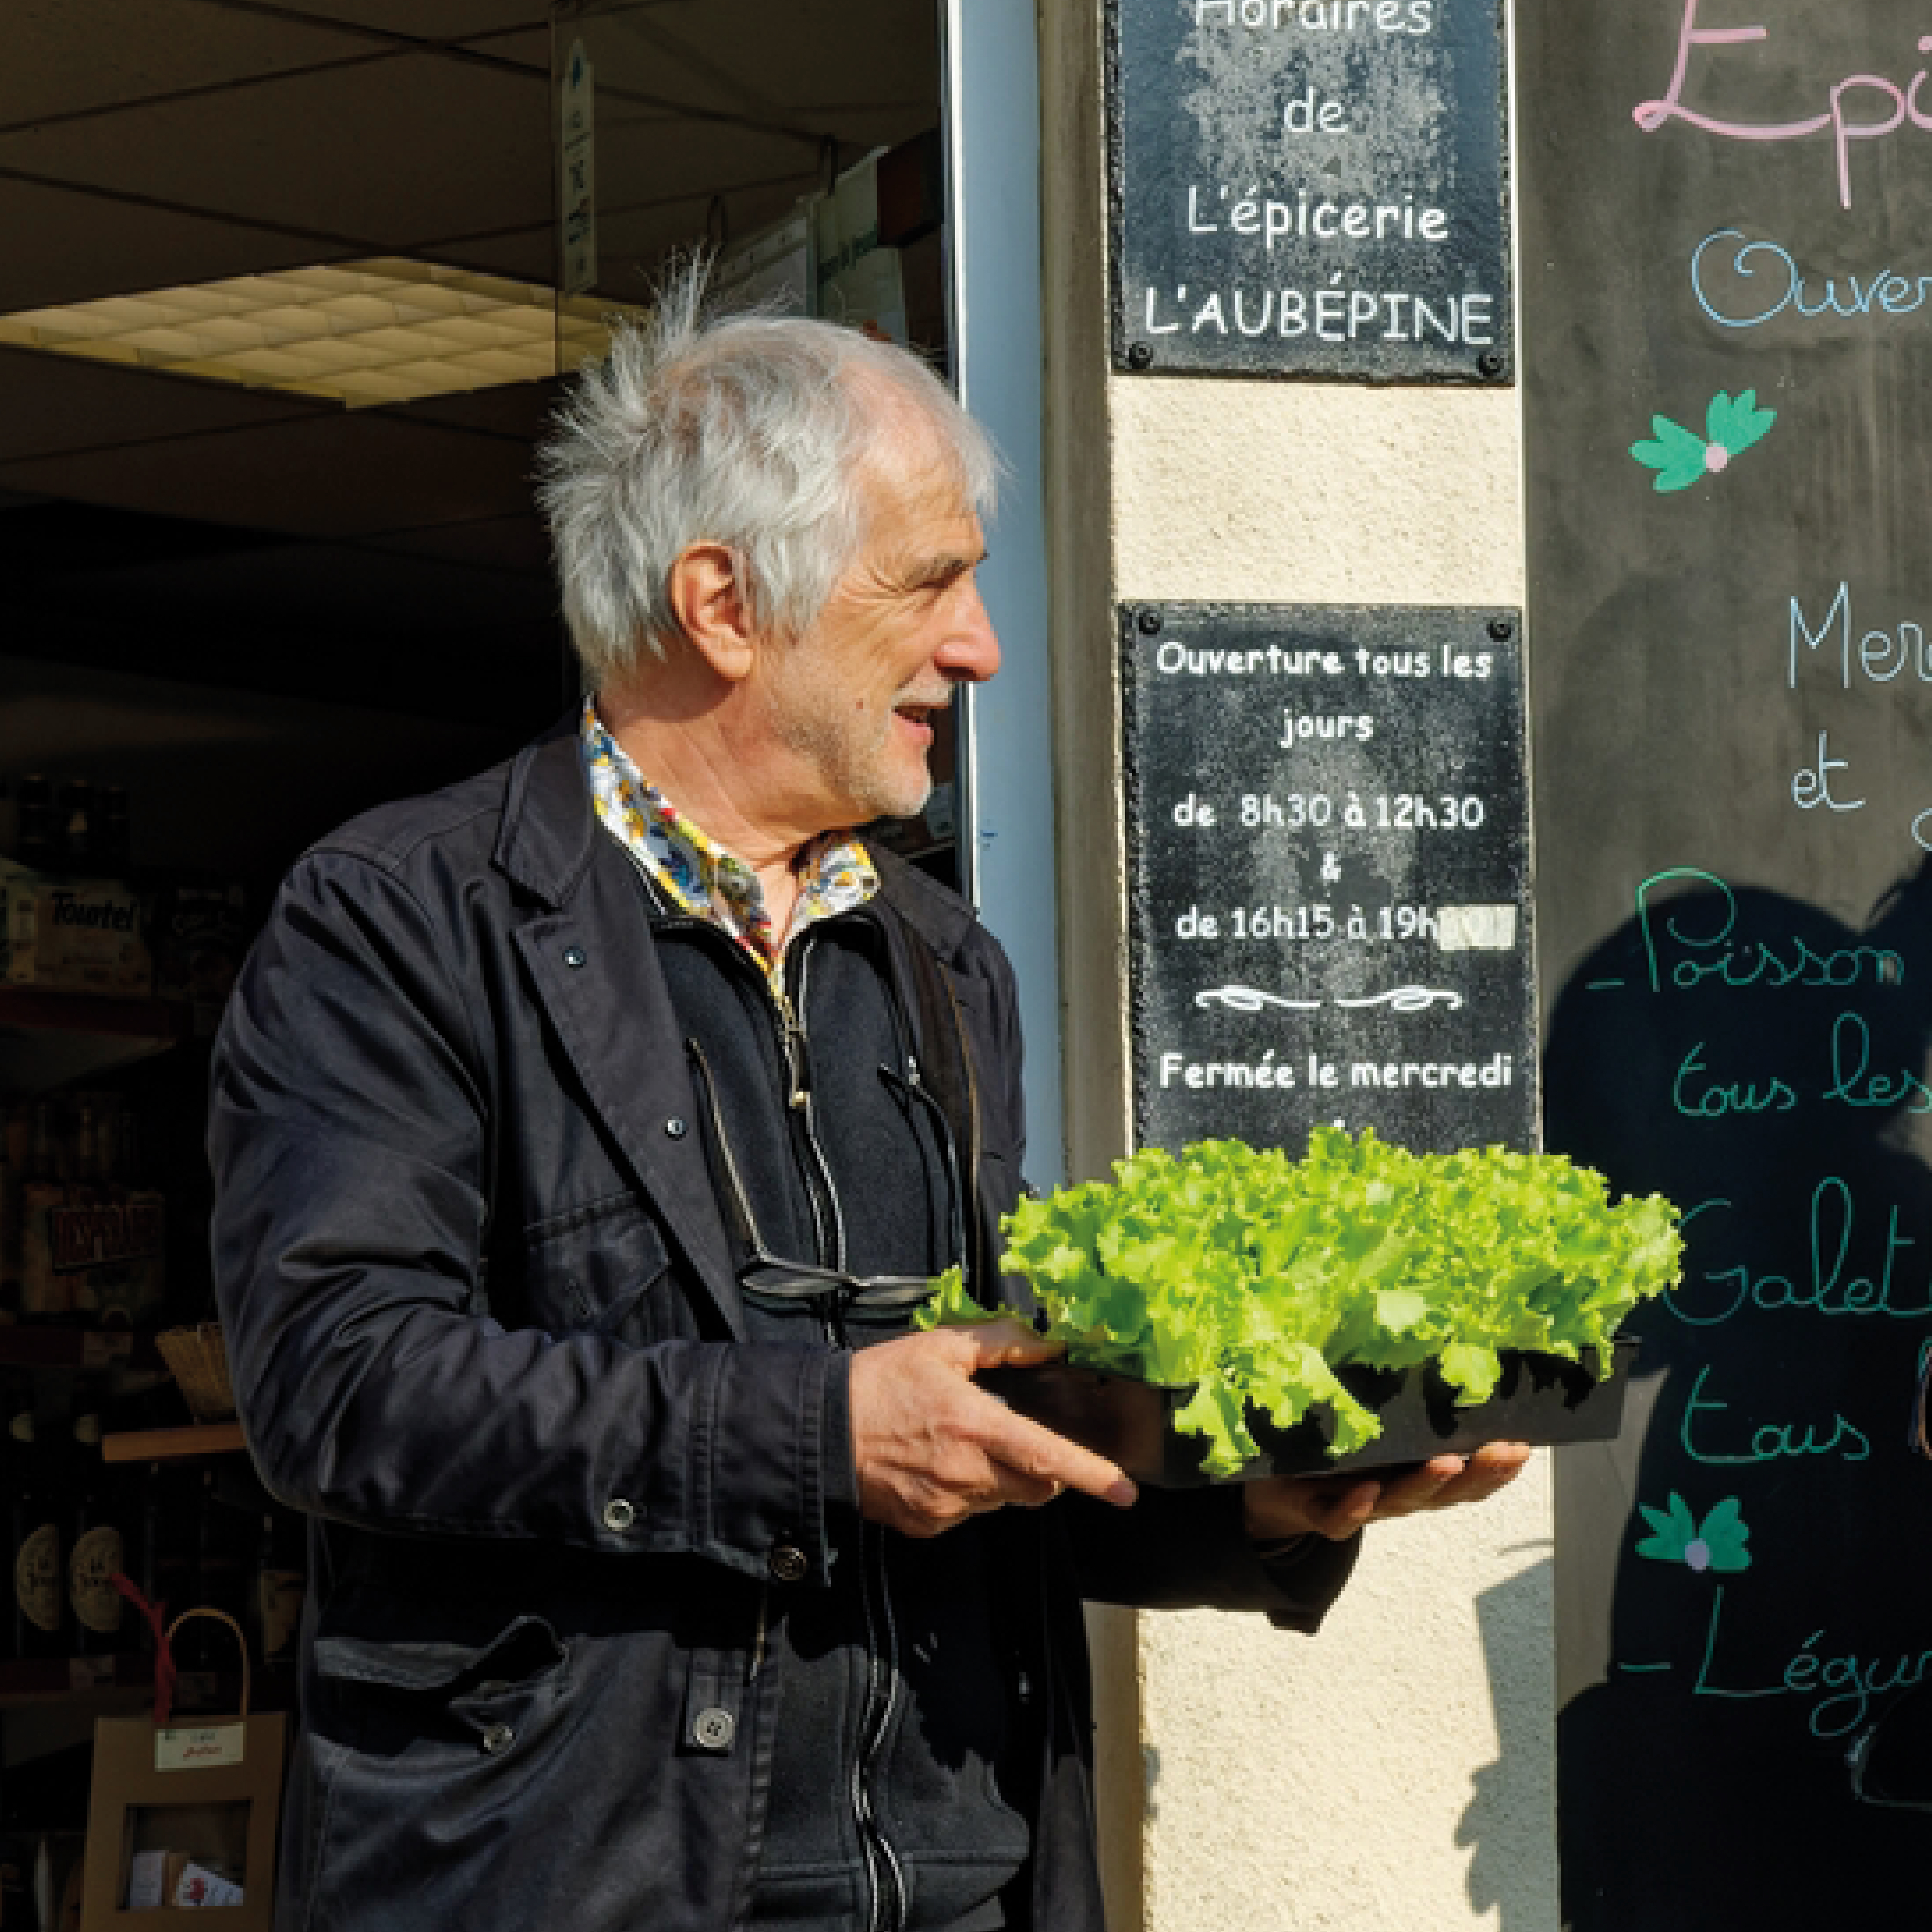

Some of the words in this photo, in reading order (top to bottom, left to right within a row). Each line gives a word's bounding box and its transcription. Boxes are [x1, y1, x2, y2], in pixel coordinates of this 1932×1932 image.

[1284, 86, 1348, 132] de
[1188, 184, 1448, 249] L'épicerie
[1145, 270, 1494, 344] L'AUBÉPINE
[1156, 641, 1345, 675] Ouverture
[1355, 645, 1430, 676] tous
[1443, 645, 1495, 678] les
[1788, 581, 1932, 689] Mer
[1281, 707, 1373, 748] jours
[1791, 730, 1866, 811] et
[1173, 791, 1216, 827] de
[1241, 793, 1332, 828] 8h30
[1344, 794, 1367, 827] à
[1376, 794, 1485, 829] 12h30
[1319, 850, 1342, 883] &
[1175, 905, 1219, 939] de
[1234, 903, 1334, 940] 16h15
[1347, 904, 1366, 939] à
[1635, 865, 1905, 992] Poisson
[1160, 1048, 1296, 1088] Fermée
[1309, 1053, 1338, 1087] le
[1351, 1052, 1512, 1088] mercredi
[1673, 1042, 1798, 1117] tous
[1822, 1011, 1932, 1113] les
[1663, 1176, 1932, 1326] Galet
